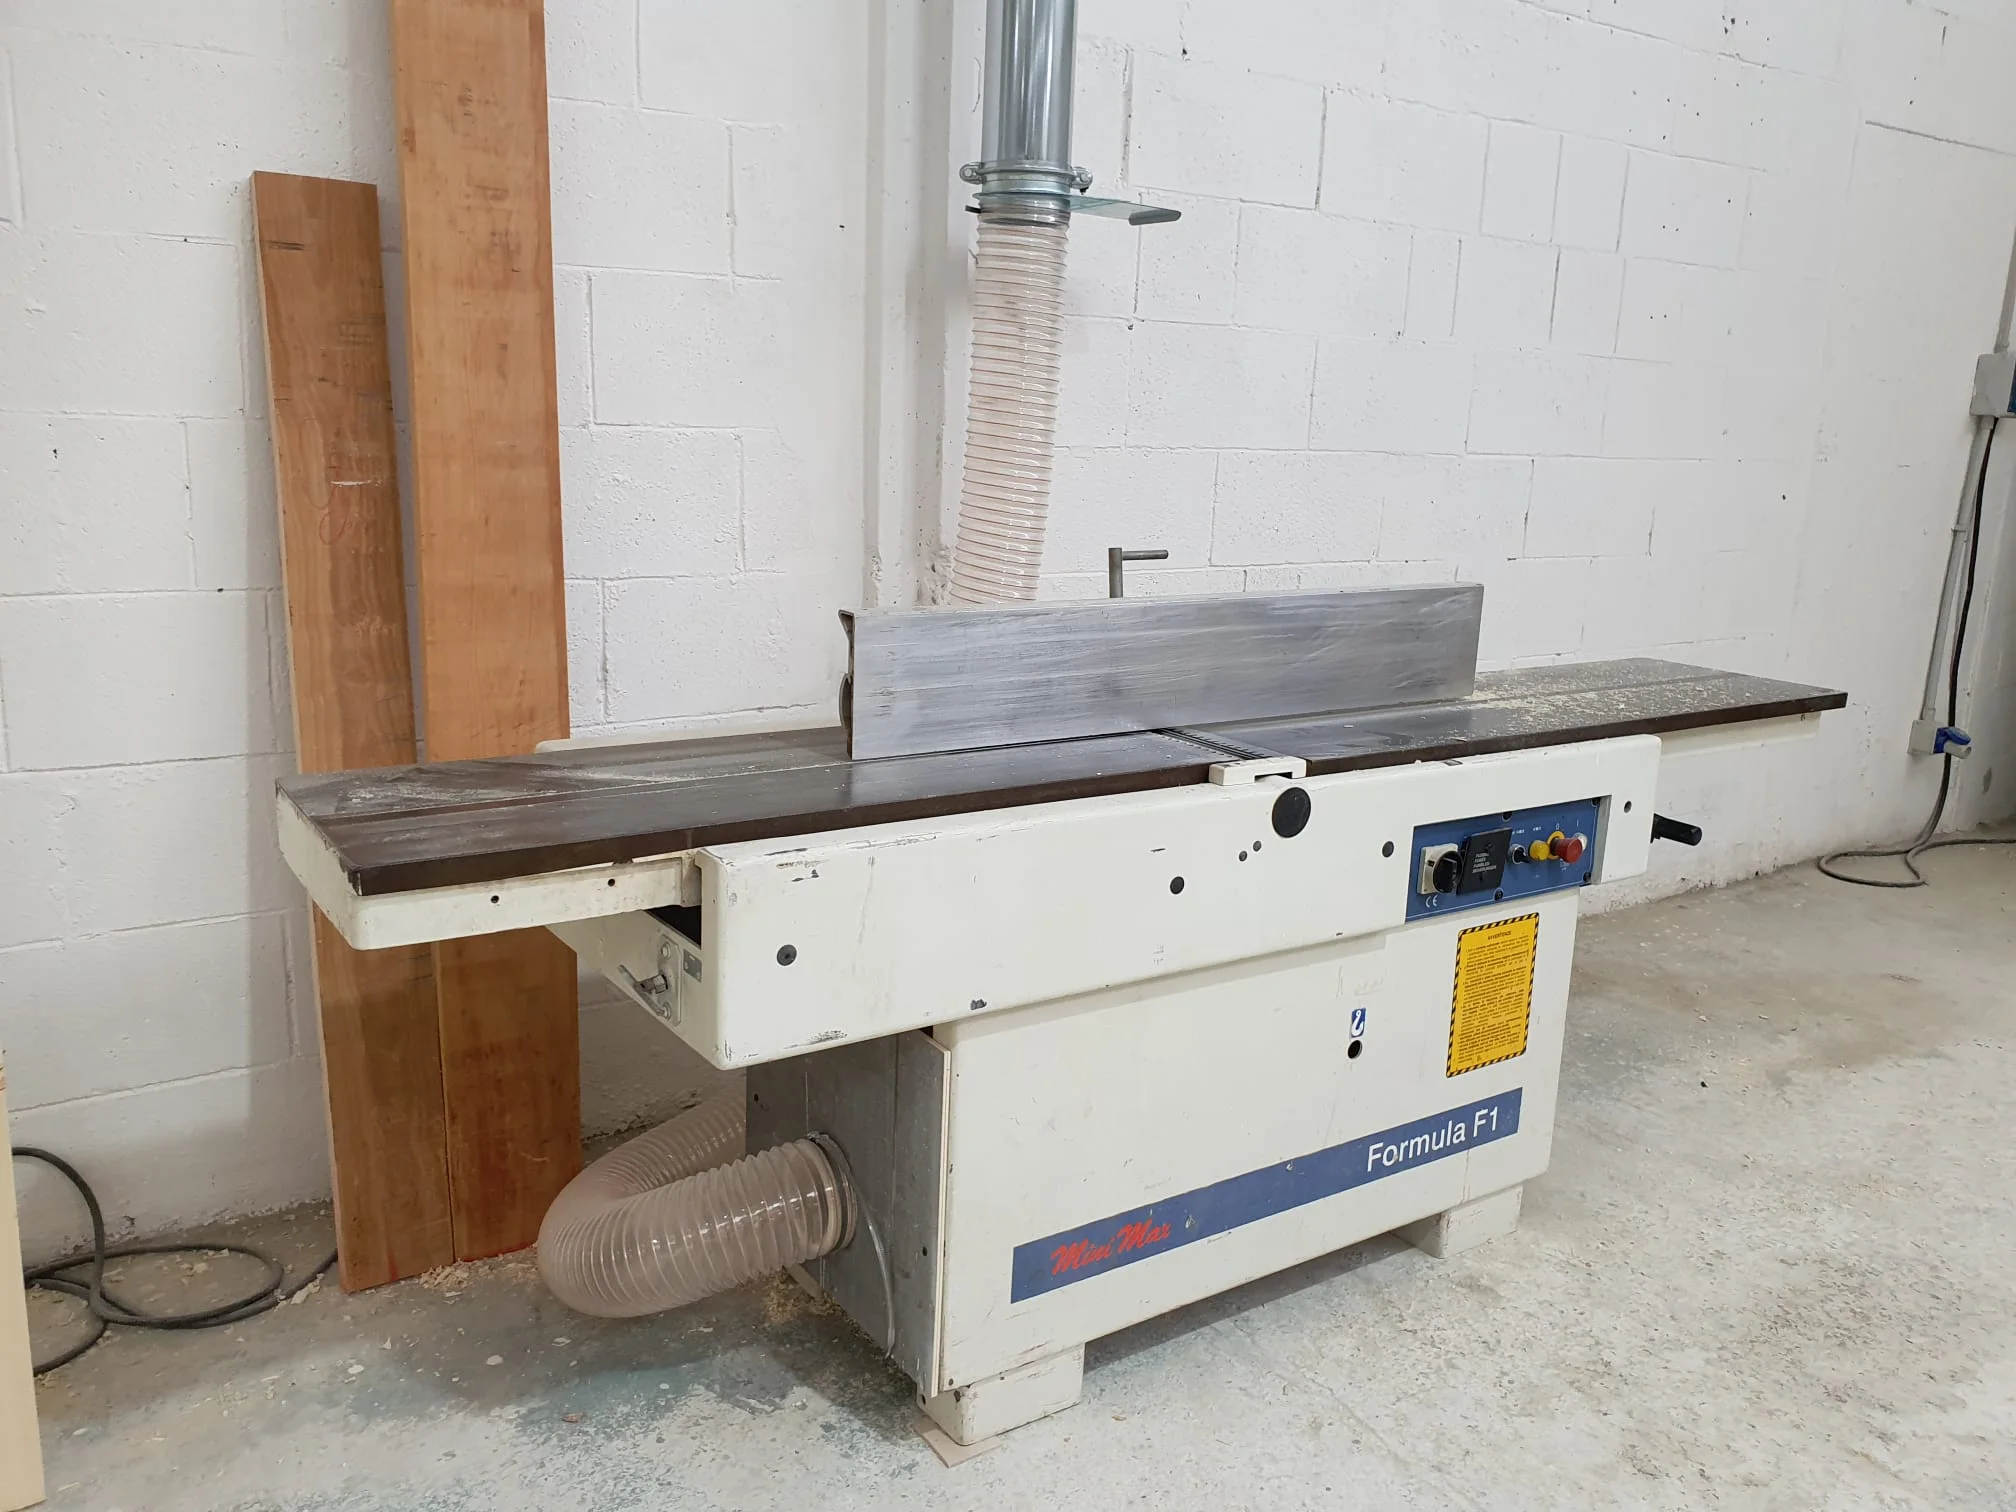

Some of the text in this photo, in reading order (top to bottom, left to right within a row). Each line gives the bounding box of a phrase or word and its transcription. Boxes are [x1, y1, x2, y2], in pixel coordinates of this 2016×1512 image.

[1425, 894, 1439, 908] CE
[1367, 1106, 1499, 1172] Formula F1
[1051, 1218, 1172, 1276] Mini Max
